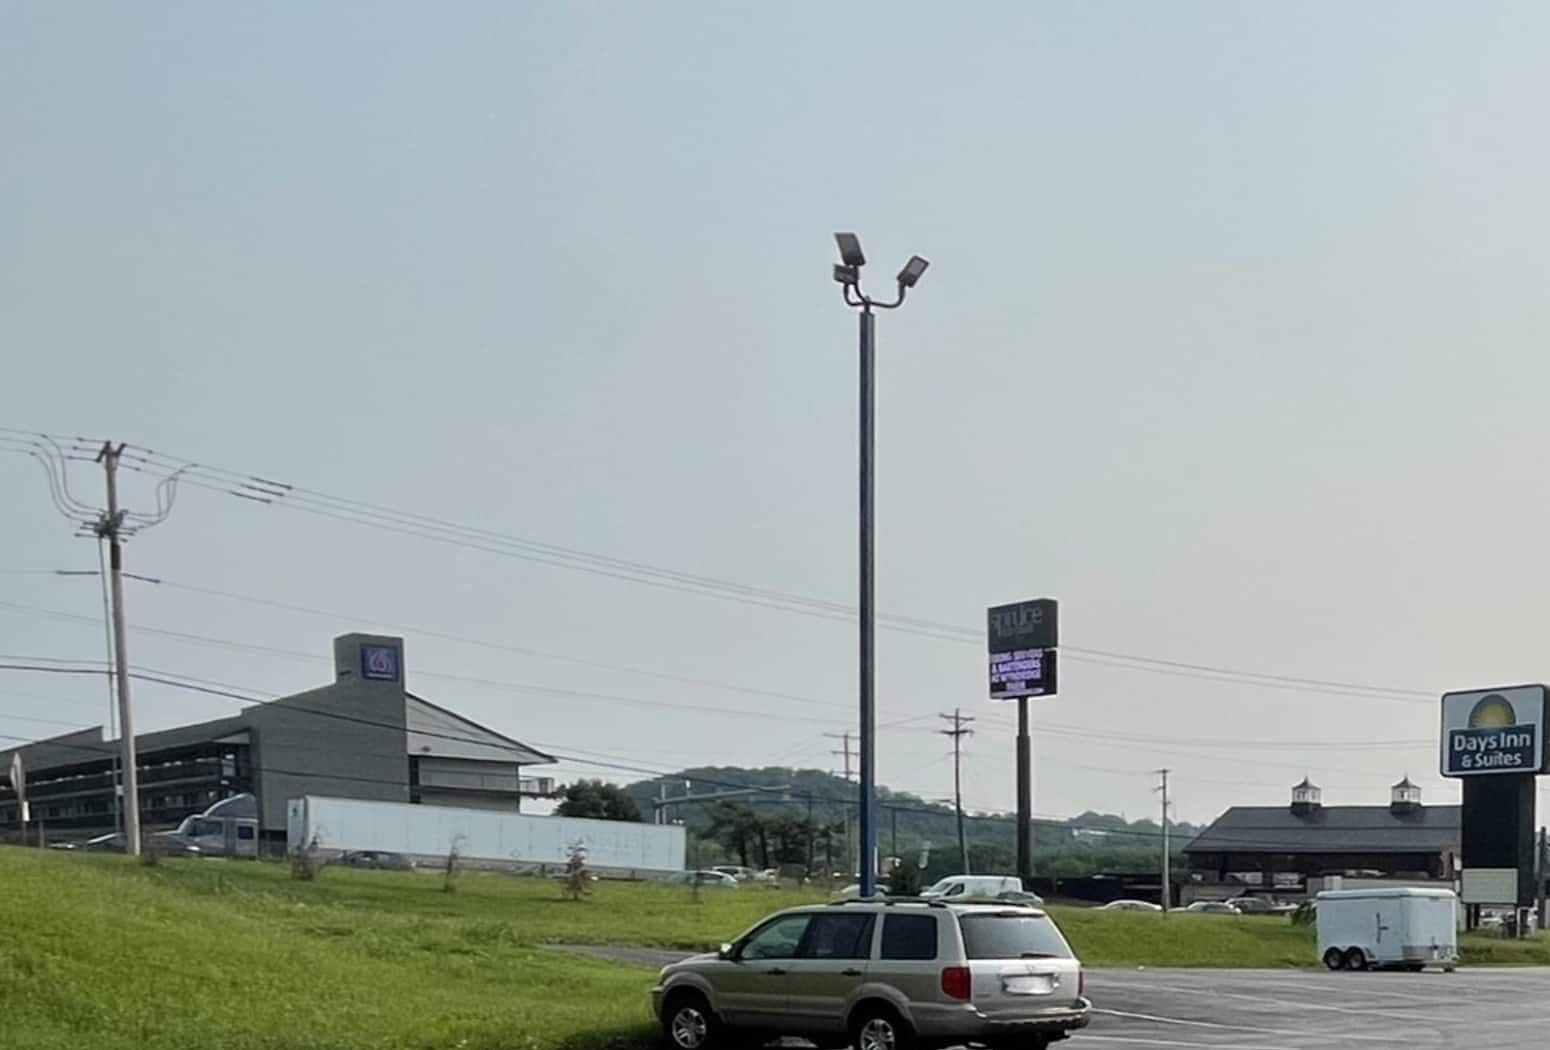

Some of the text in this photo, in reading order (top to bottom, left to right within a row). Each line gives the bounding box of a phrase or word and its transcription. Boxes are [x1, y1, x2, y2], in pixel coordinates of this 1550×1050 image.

[1454, 733, 1531, 752] Days Inn
[1461, 752, 1522, 768] & Suites
